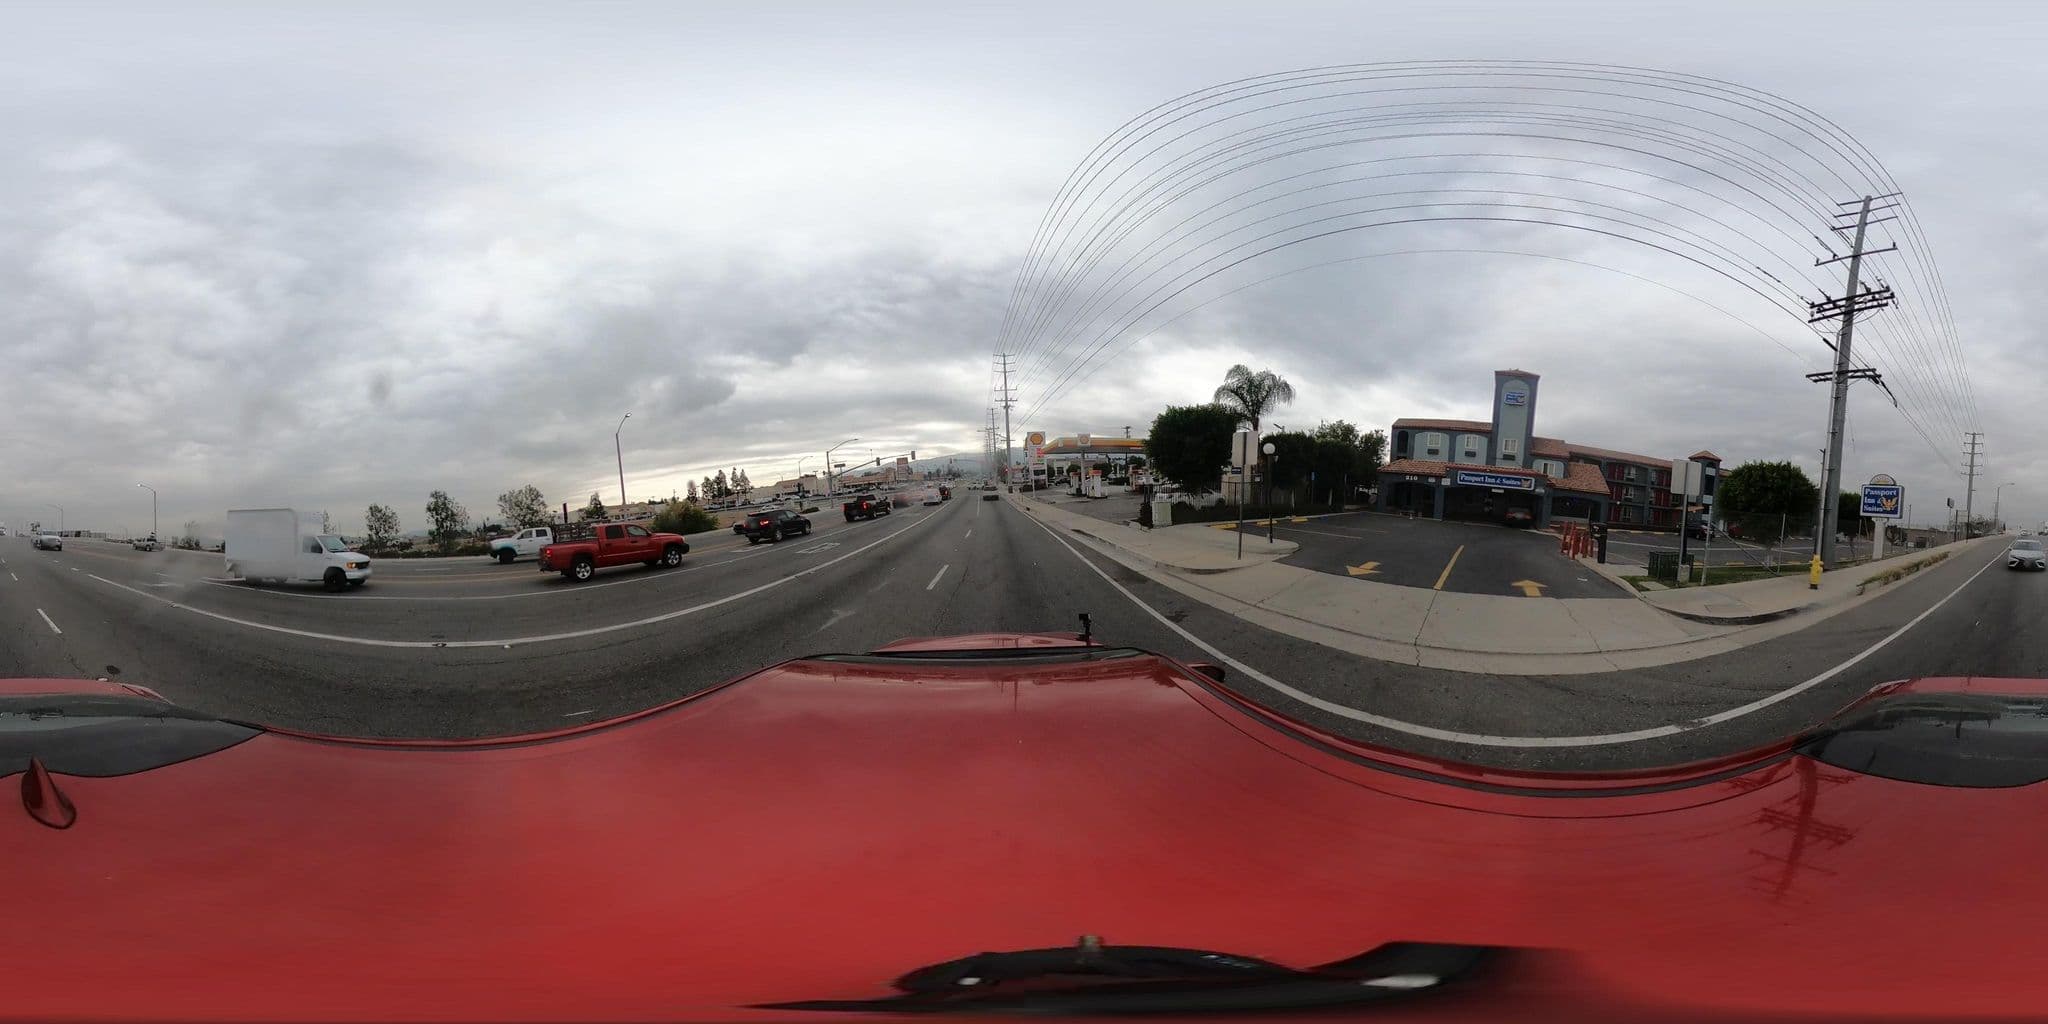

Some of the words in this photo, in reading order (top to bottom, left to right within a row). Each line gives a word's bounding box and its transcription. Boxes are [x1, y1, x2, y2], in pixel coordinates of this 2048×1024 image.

[1461, 474, 1484, 483] Passport
[1502, 477, 1521, 485] Suites
[1865, 488, 1897, 497] Passport
[1863, 504, 1883, 512] Suites
